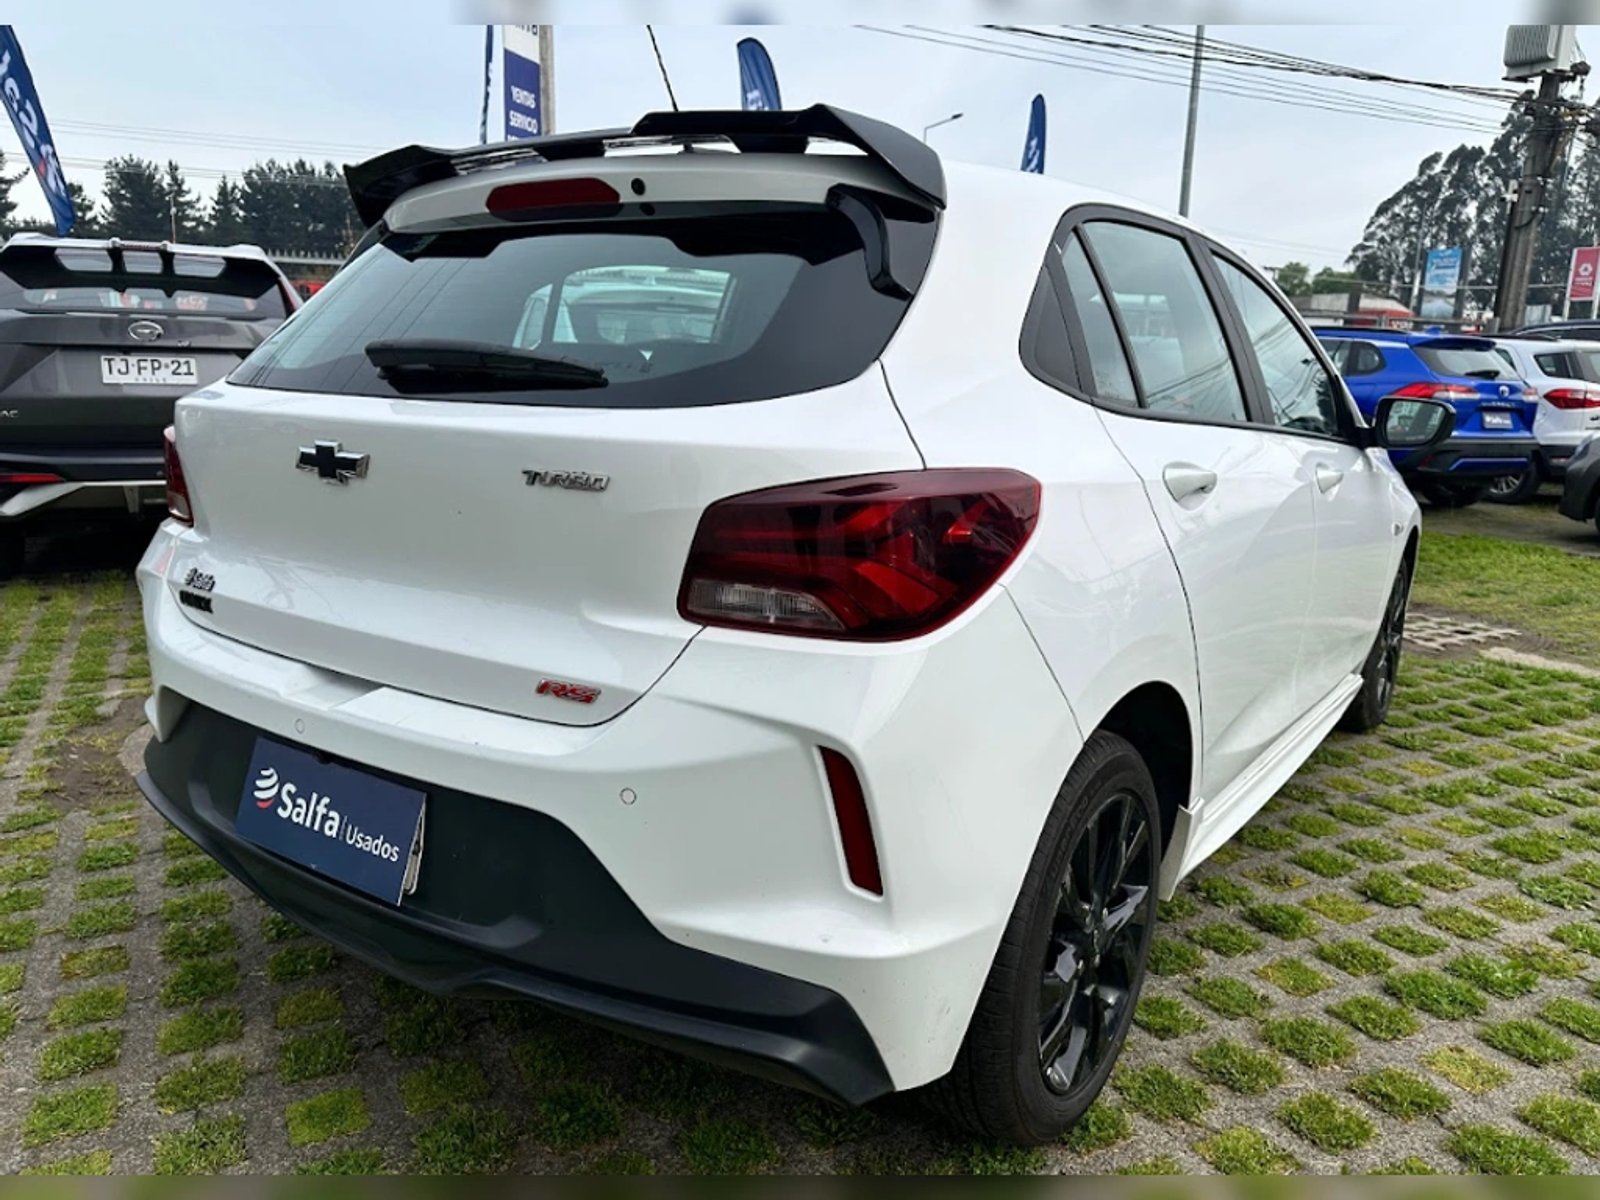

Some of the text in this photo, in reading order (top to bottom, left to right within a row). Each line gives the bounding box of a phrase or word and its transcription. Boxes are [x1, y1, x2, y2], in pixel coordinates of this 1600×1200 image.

[522, 469, 610, 492] TURBO
[535, 679, 602, 704] RS
[276, 781, 400, 863] Salfa Usados
